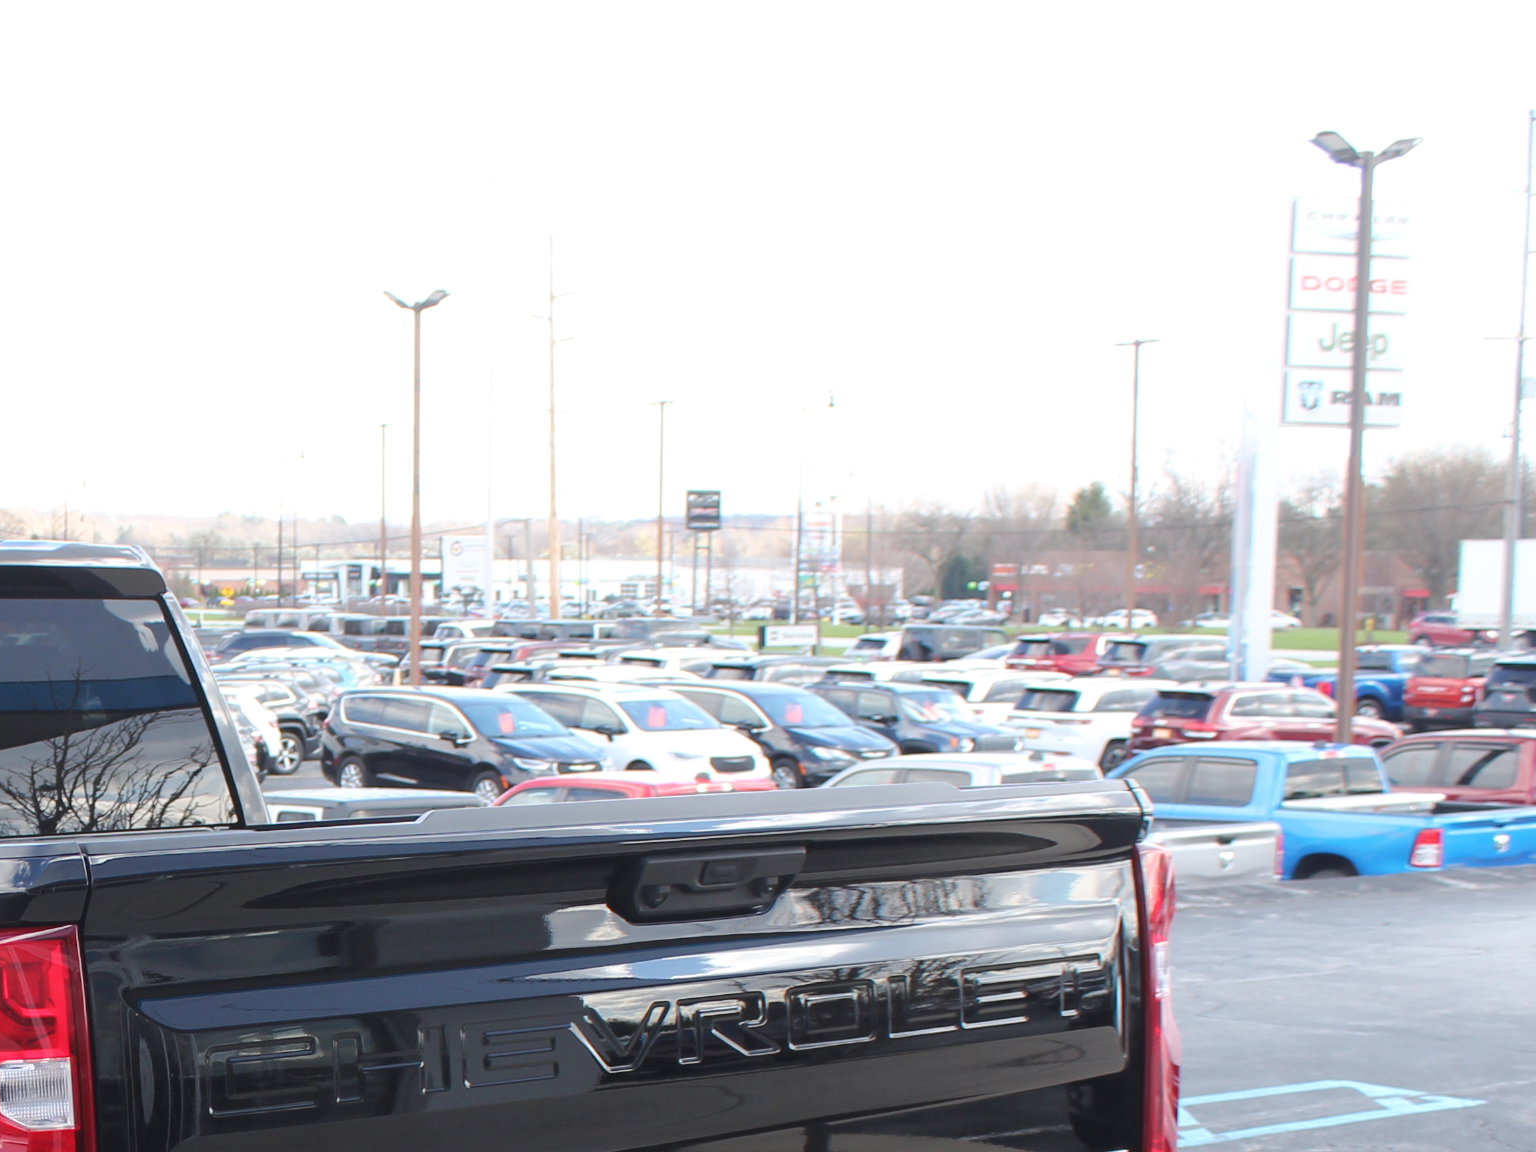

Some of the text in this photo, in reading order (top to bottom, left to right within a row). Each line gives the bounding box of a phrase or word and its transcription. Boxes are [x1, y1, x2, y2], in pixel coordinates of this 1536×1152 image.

[1306, 211, 1409, 224] CHRLER
[1319, 322, 1388, 360] Jep
[205, 953, 1102, 1117] CHEVROLET
